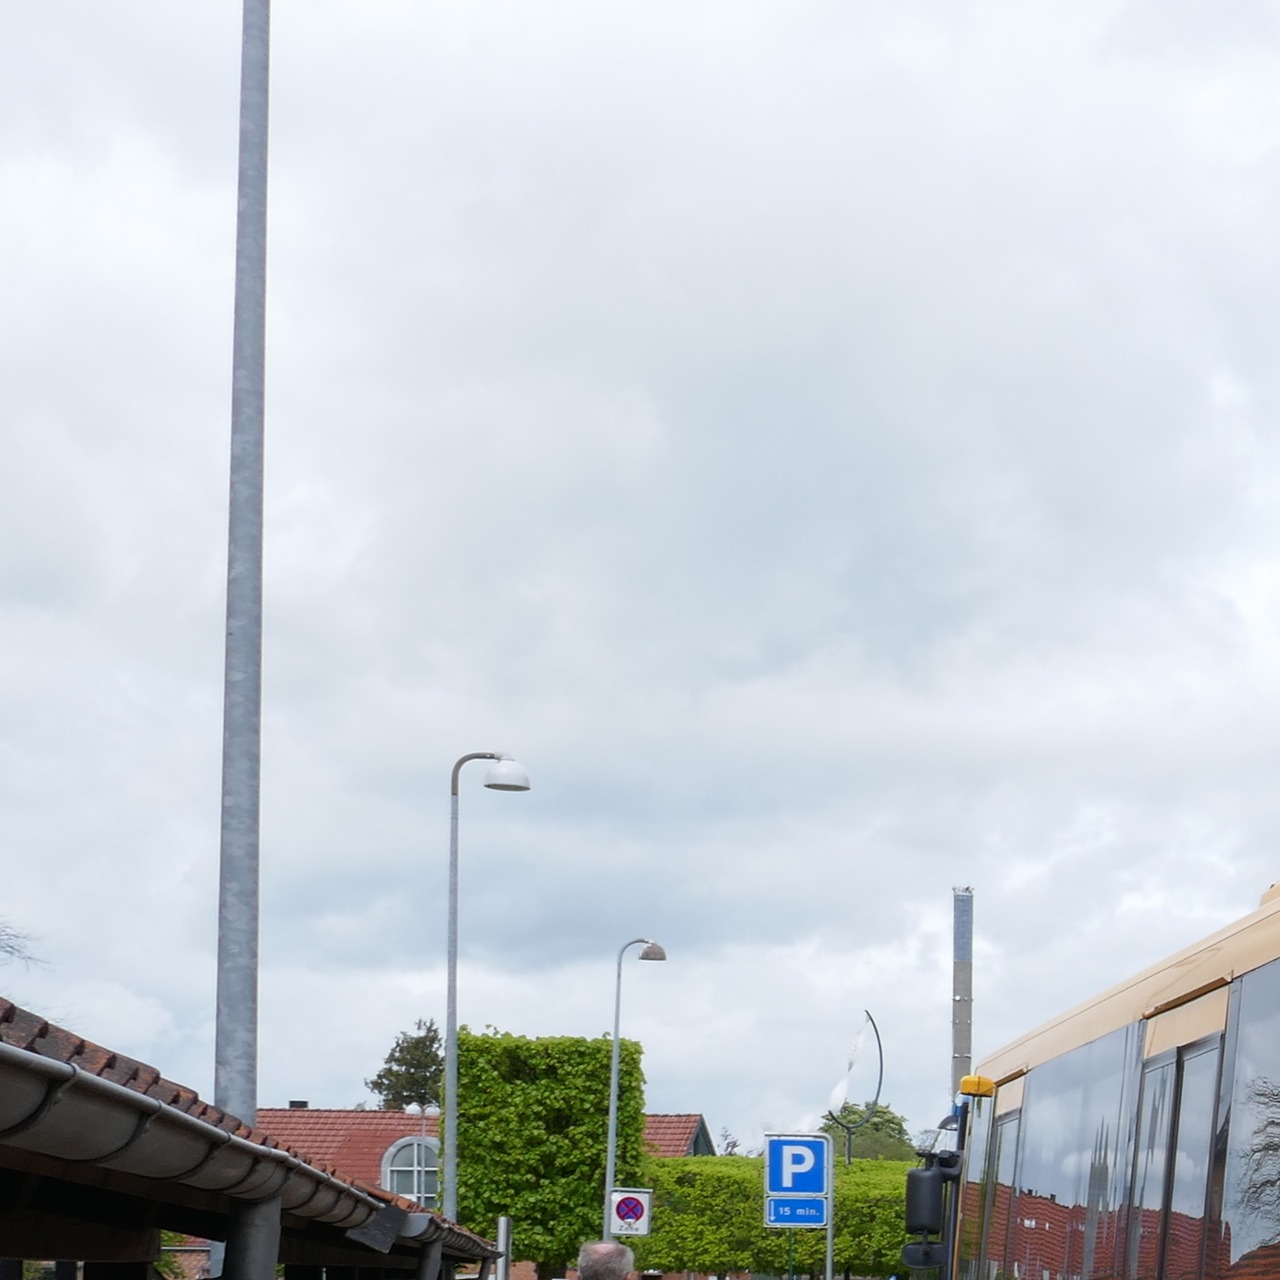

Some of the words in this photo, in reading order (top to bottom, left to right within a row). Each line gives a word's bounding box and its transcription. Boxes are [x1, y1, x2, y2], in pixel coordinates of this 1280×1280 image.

[781, 1145, 815, 1188] P
[778, 1207, 792, 1216] 15
[796, 1207, 820, 1216] min.
